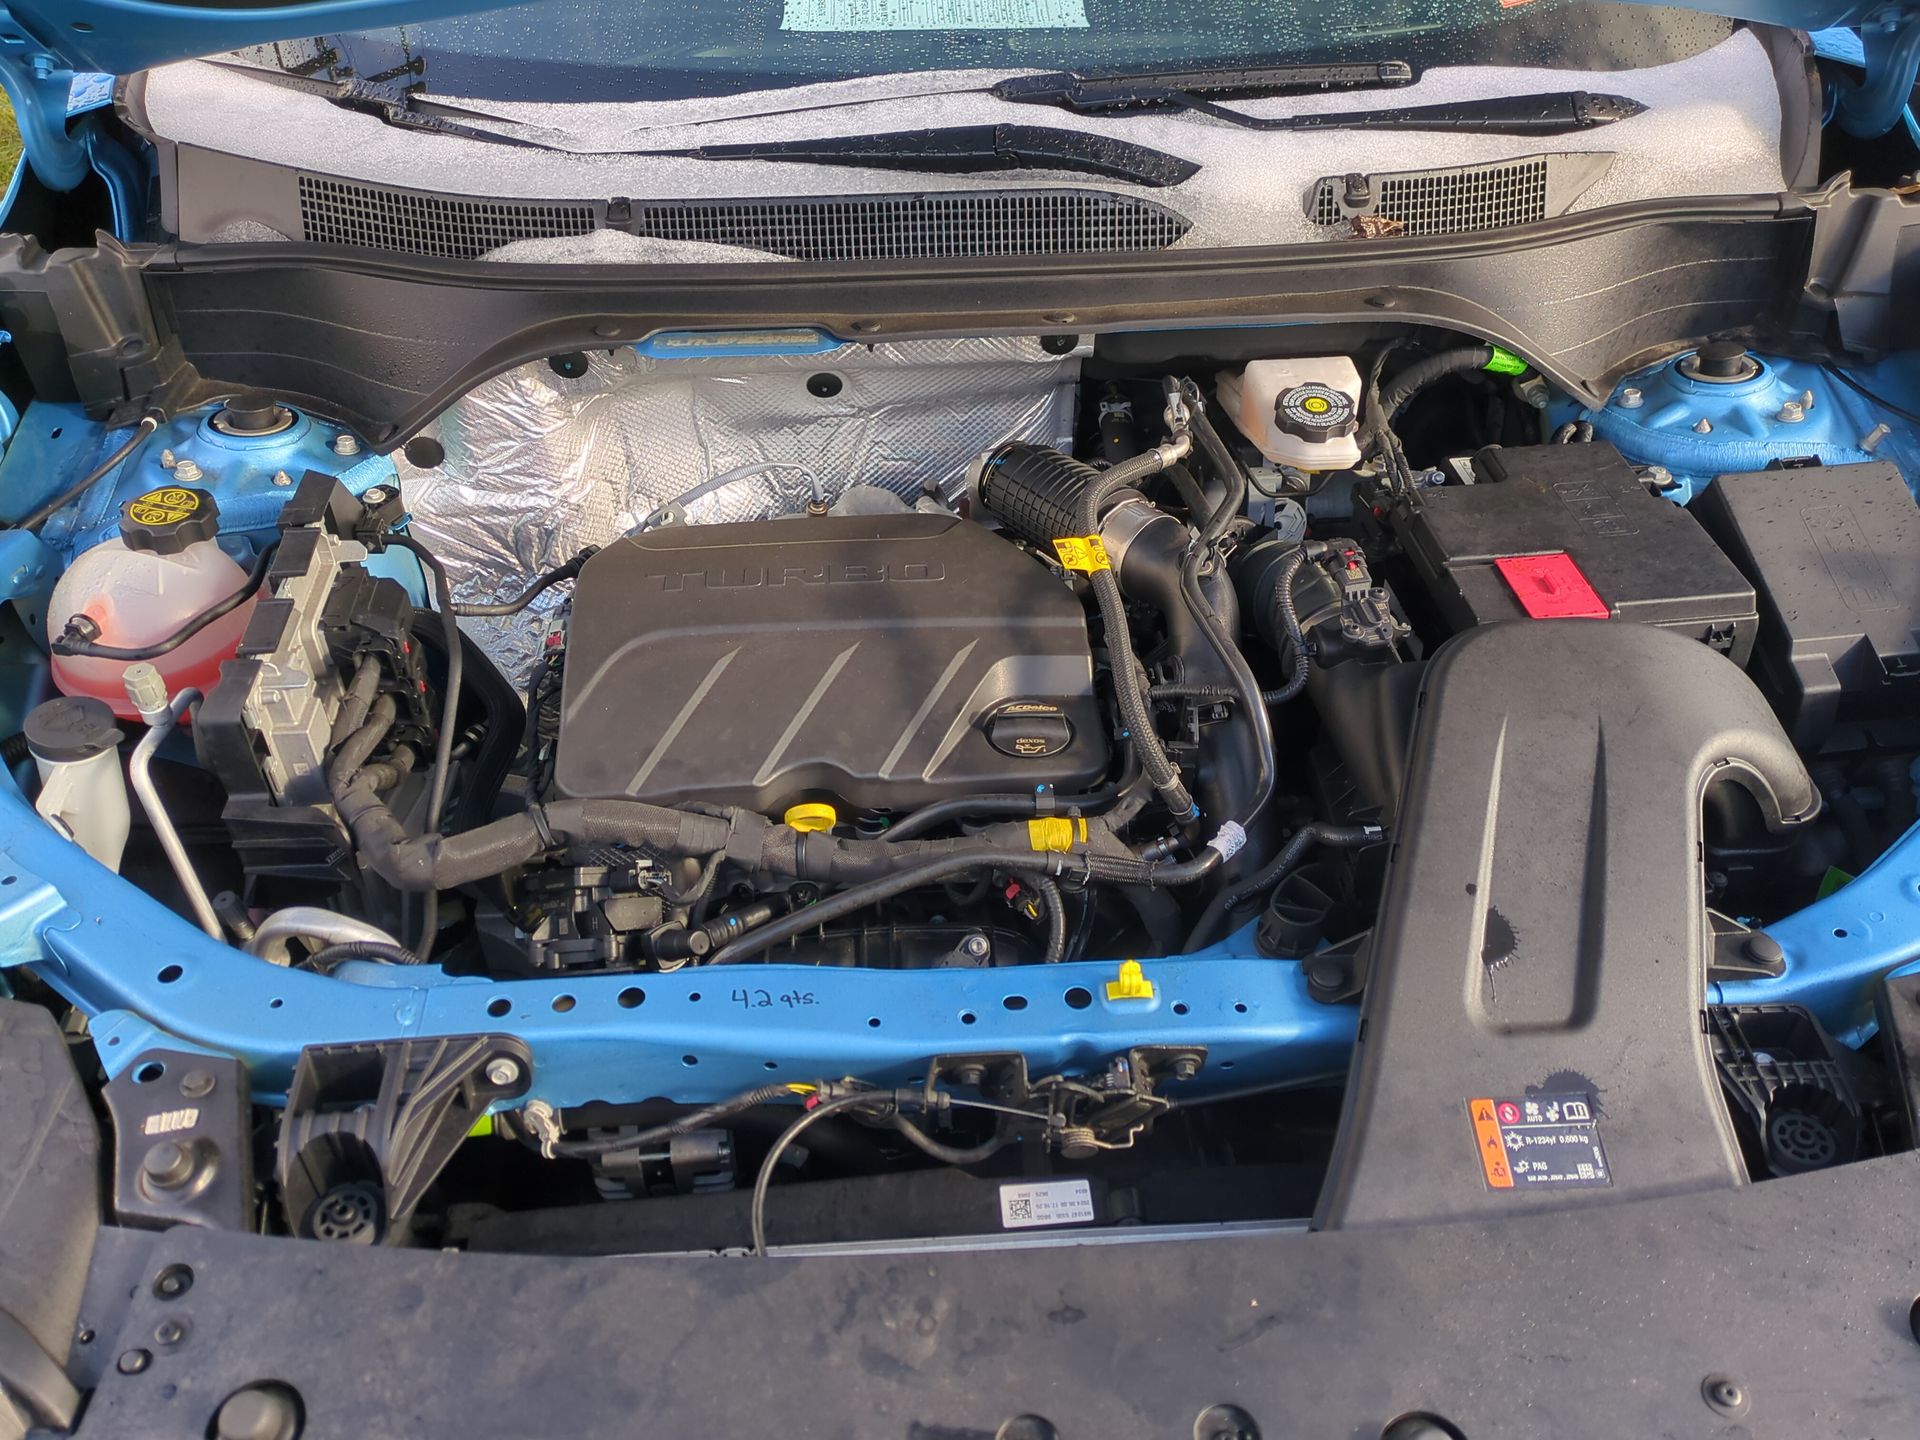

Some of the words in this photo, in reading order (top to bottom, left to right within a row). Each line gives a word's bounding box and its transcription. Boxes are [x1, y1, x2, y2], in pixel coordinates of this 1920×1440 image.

[646, 562, 945, 591] TURBO
[1005, 705, 1058, 713] ACDelco
[731, 989, 773, 1009] 4.2
[780, 990, 820, 1008] qts.
[1579, 1135, 1589, 1144] kg
[1532, 1162, 1548, 1171] PAG
